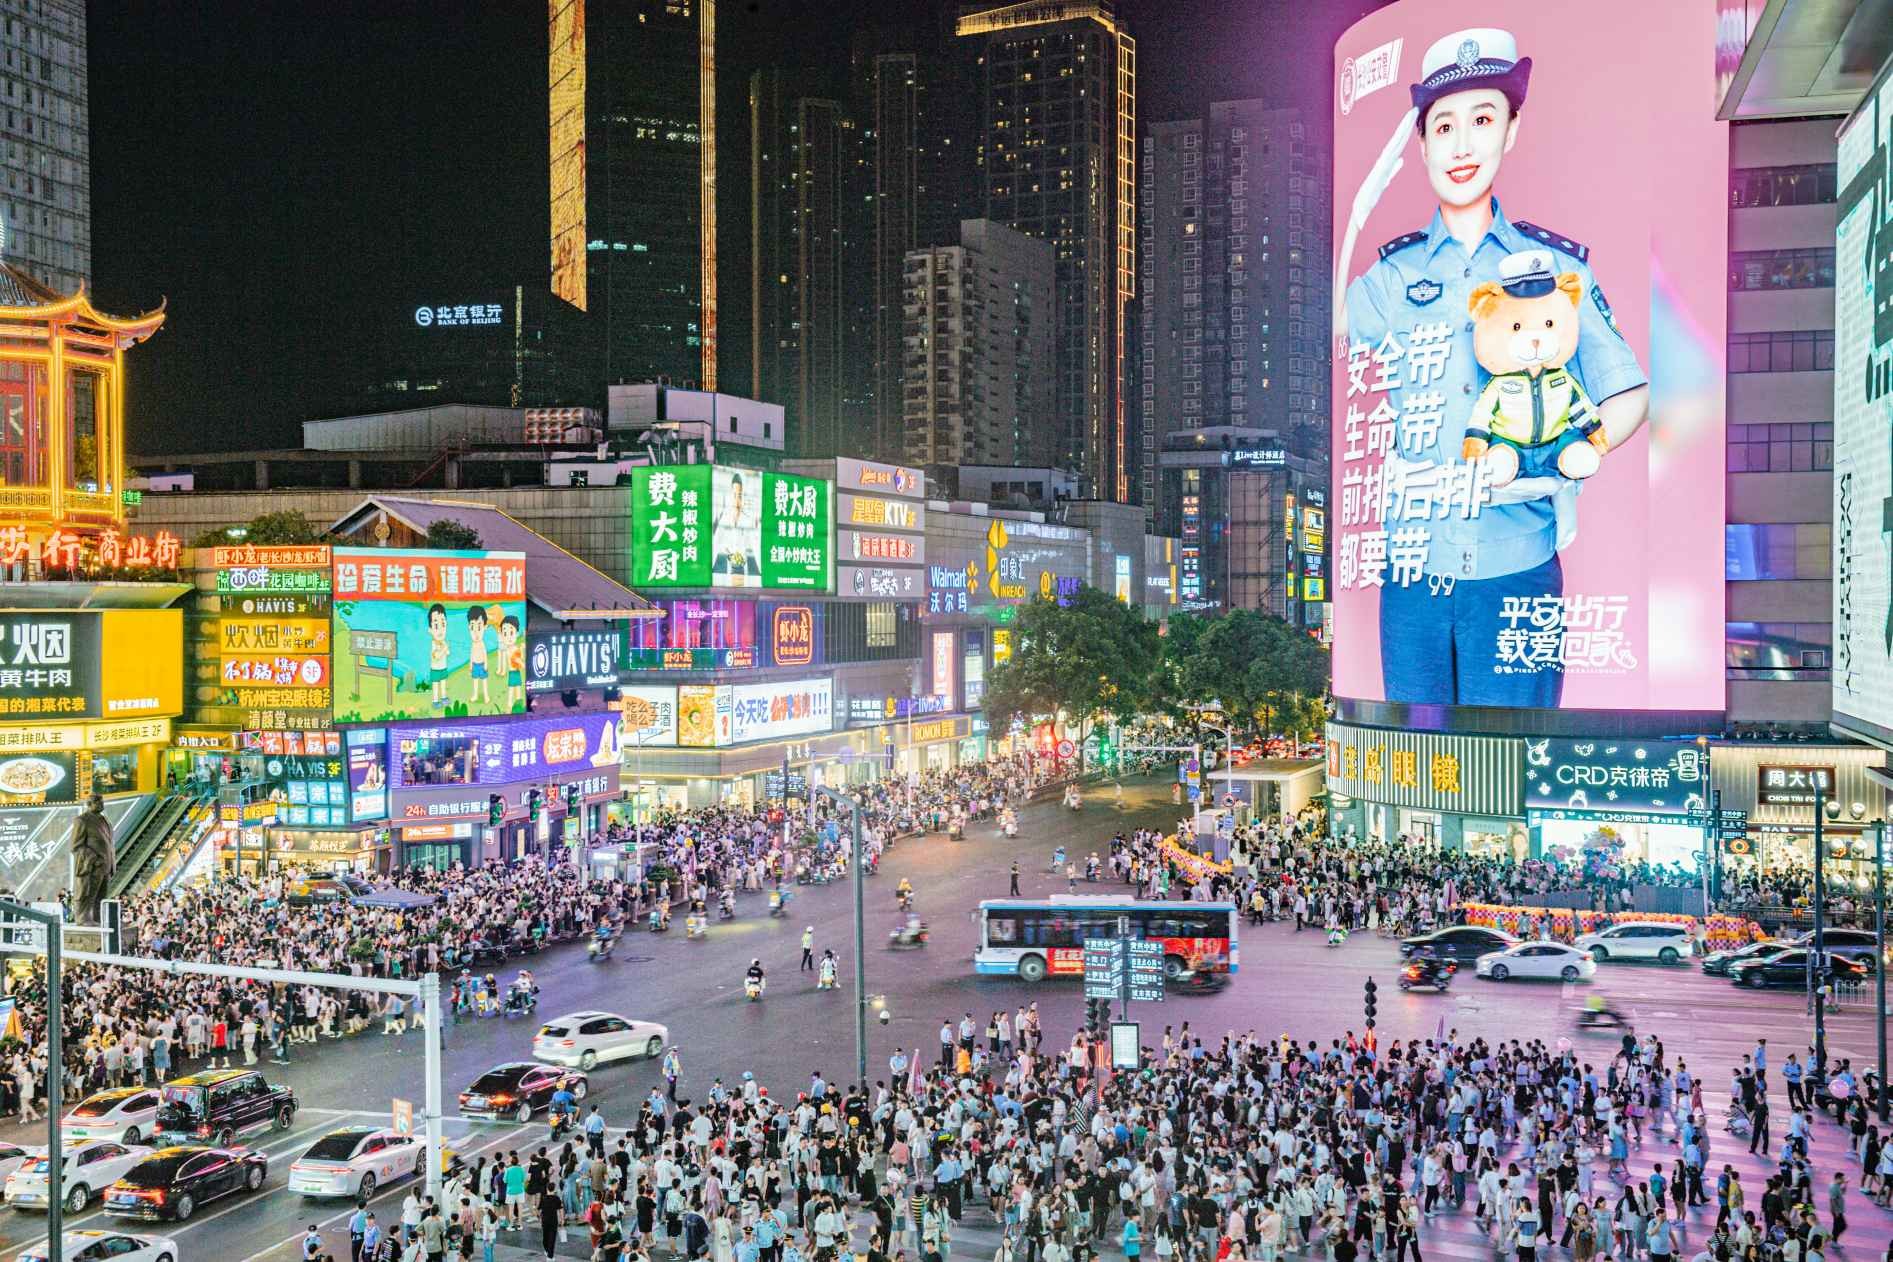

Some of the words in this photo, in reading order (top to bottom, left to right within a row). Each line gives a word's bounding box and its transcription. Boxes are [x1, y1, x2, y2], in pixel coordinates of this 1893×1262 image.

[437, 304, 503, 318] 北京银行
[471, 317, 501, 325] BEIJING
[1343, 390, 1446, 462] 生命带
[774, 479, 817, 519] 费大厨
[1342, 455, 1494, 526] 前排后排
[648, 471, 680, 581] 费大厨
[681, 490, 698, 562] 辣椒炒肉
[337, 563, 428, 593] 珍爱生命
[440, 565, 522, 594] 谨防溺水
[931, 566, 966, 587] Walmart
[1001, 557, 1025, 580] 印象汇
[256, 602, 295, 613] HAVIS
[931, 592, 967, 613] 沃尔玛
[1500, 594, 1628, 631] 平安出行
[780, 611, 809, 643] 虾小龙
[0, 623, 71, 664] 烟
[1495, 628, 1638, 669] 载爱回家
[551, 642, 611, 677] HAVIS
[0, 670, 72, 688] 黄牛肉
[561, 776, 608, 799] 中工商银行
[1556, 765, 1608, 785] CRD
[1610, 766, 1670, 788] 克徕帝
[406, 805, 427, 817] 24h
[0, 841, 57, 867] 我来了
